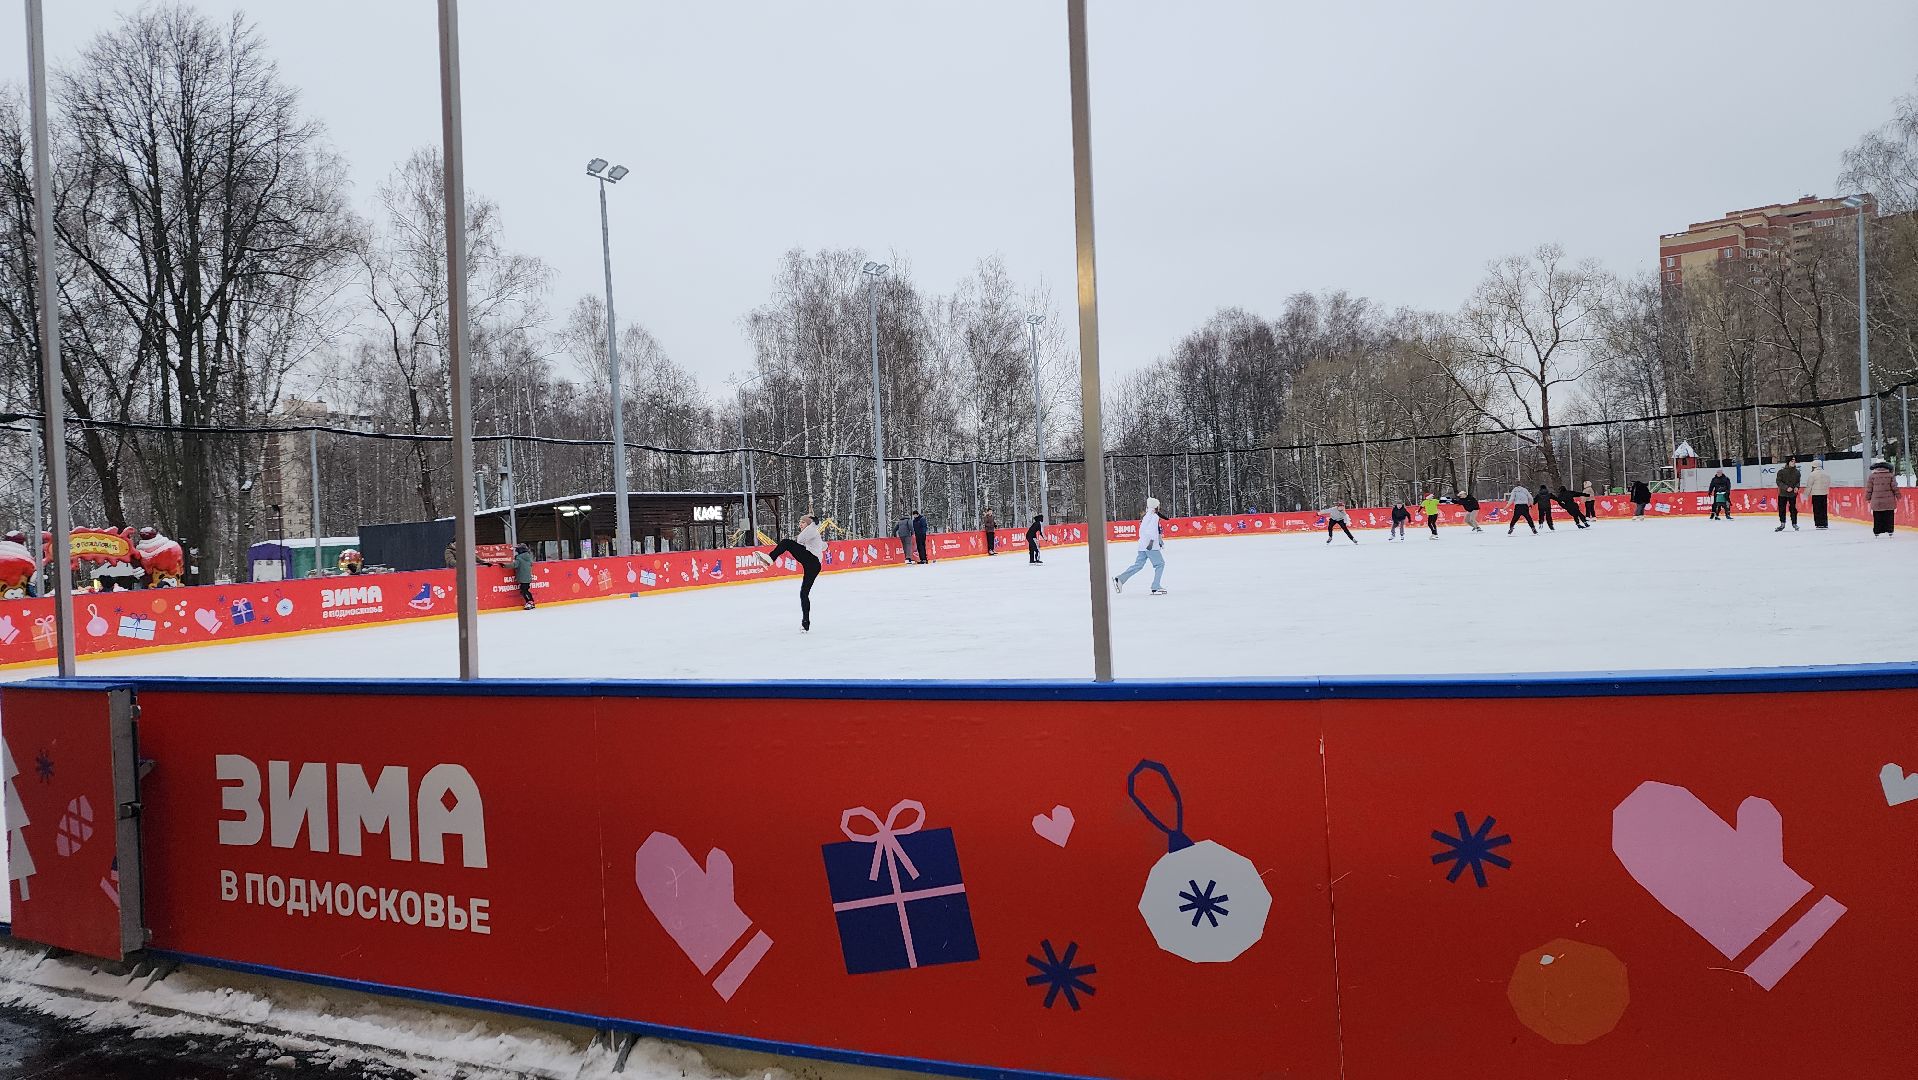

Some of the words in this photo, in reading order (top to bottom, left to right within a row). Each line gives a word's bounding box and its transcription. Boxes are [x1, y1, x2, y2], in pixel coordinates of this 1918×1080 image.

[693, 505, 723, 521] КАФЕ
[1113, 525, 1137, 534] ЗИМА
[320, 585, 383, 608] ЗИМА
[215, 754, 488, 869] ЗИМА
[220, 869, 239, 903] В
[244, 872, 491, 935] ПОДМОСКОВЬЕ
